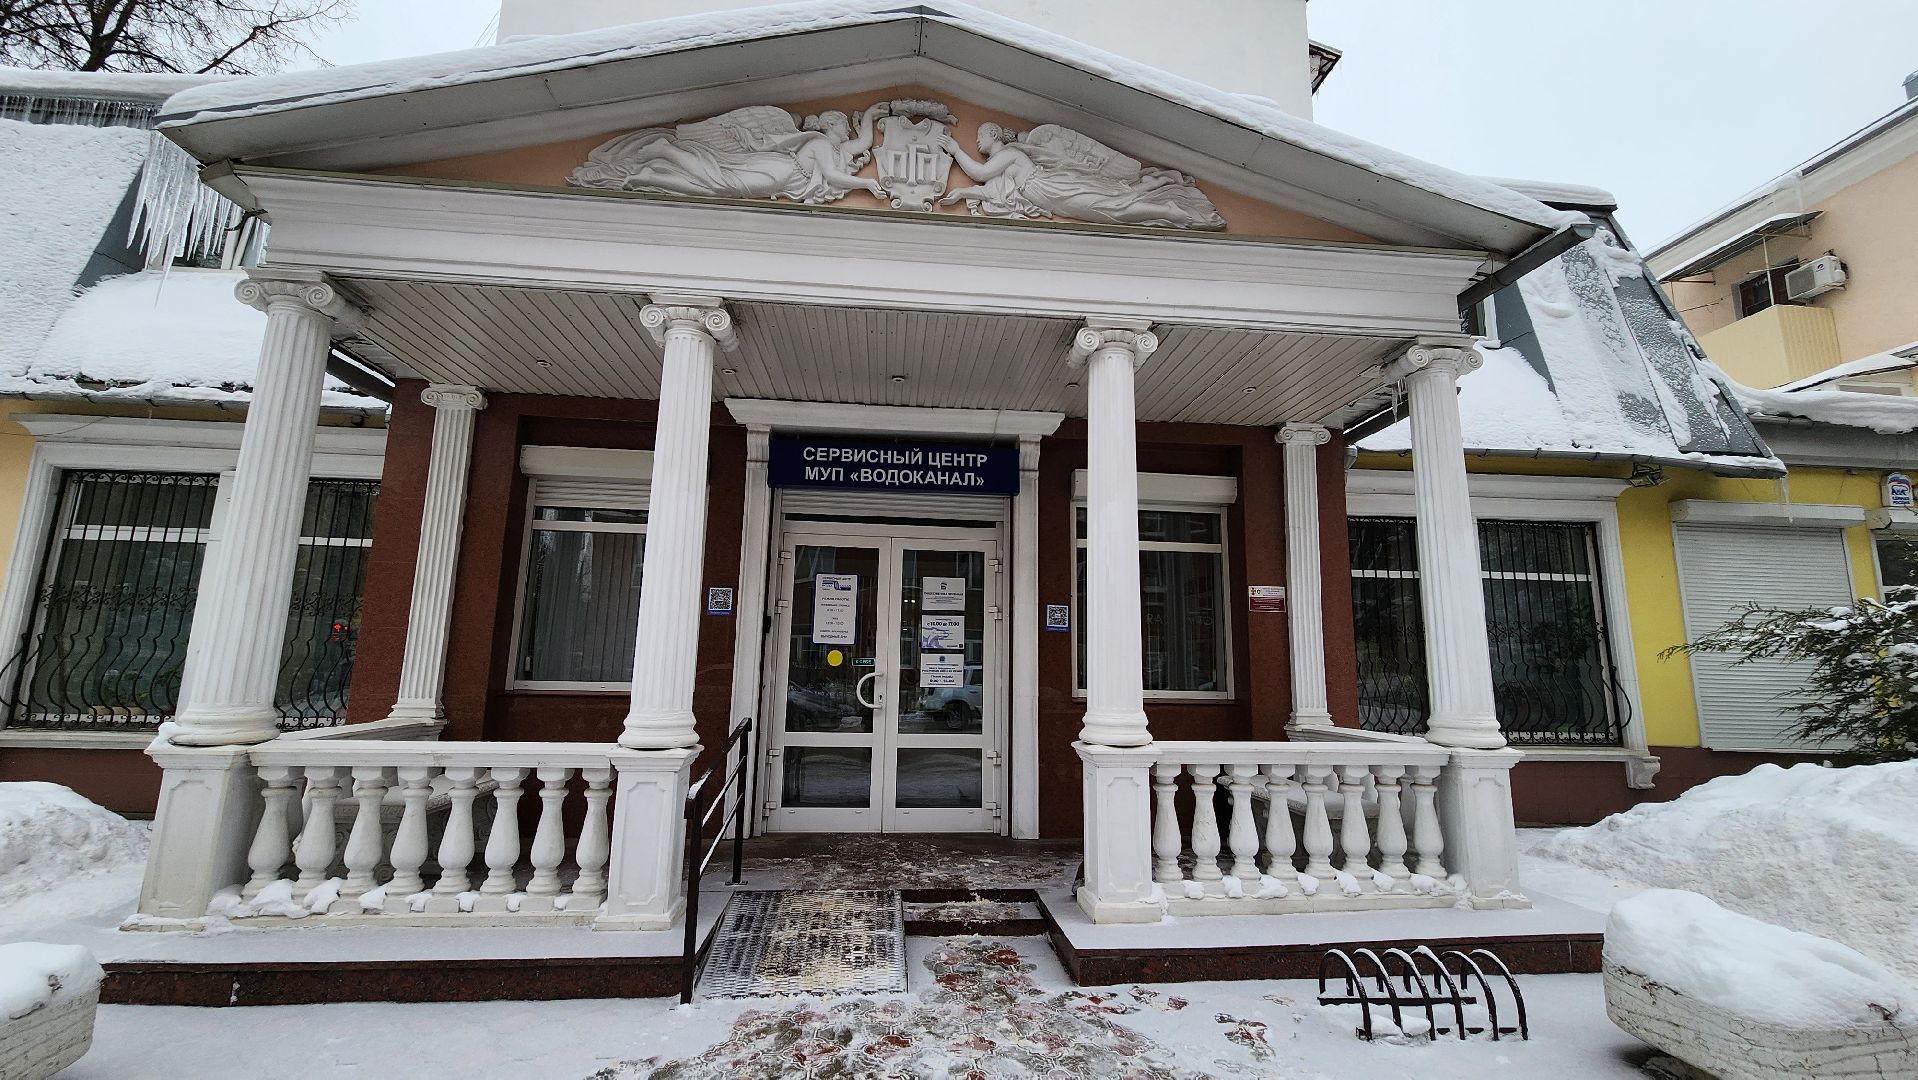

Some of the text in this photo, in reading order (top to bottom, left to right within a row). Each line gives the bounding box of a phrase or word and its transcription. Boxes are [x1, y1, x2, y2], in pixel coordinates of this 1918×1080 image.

[802, 447, 988, 468] СЕРВИСНЫЙ ЦЕНТР
[805, 467, 985, 486] МУП «ВОДОКАНАЛ»
